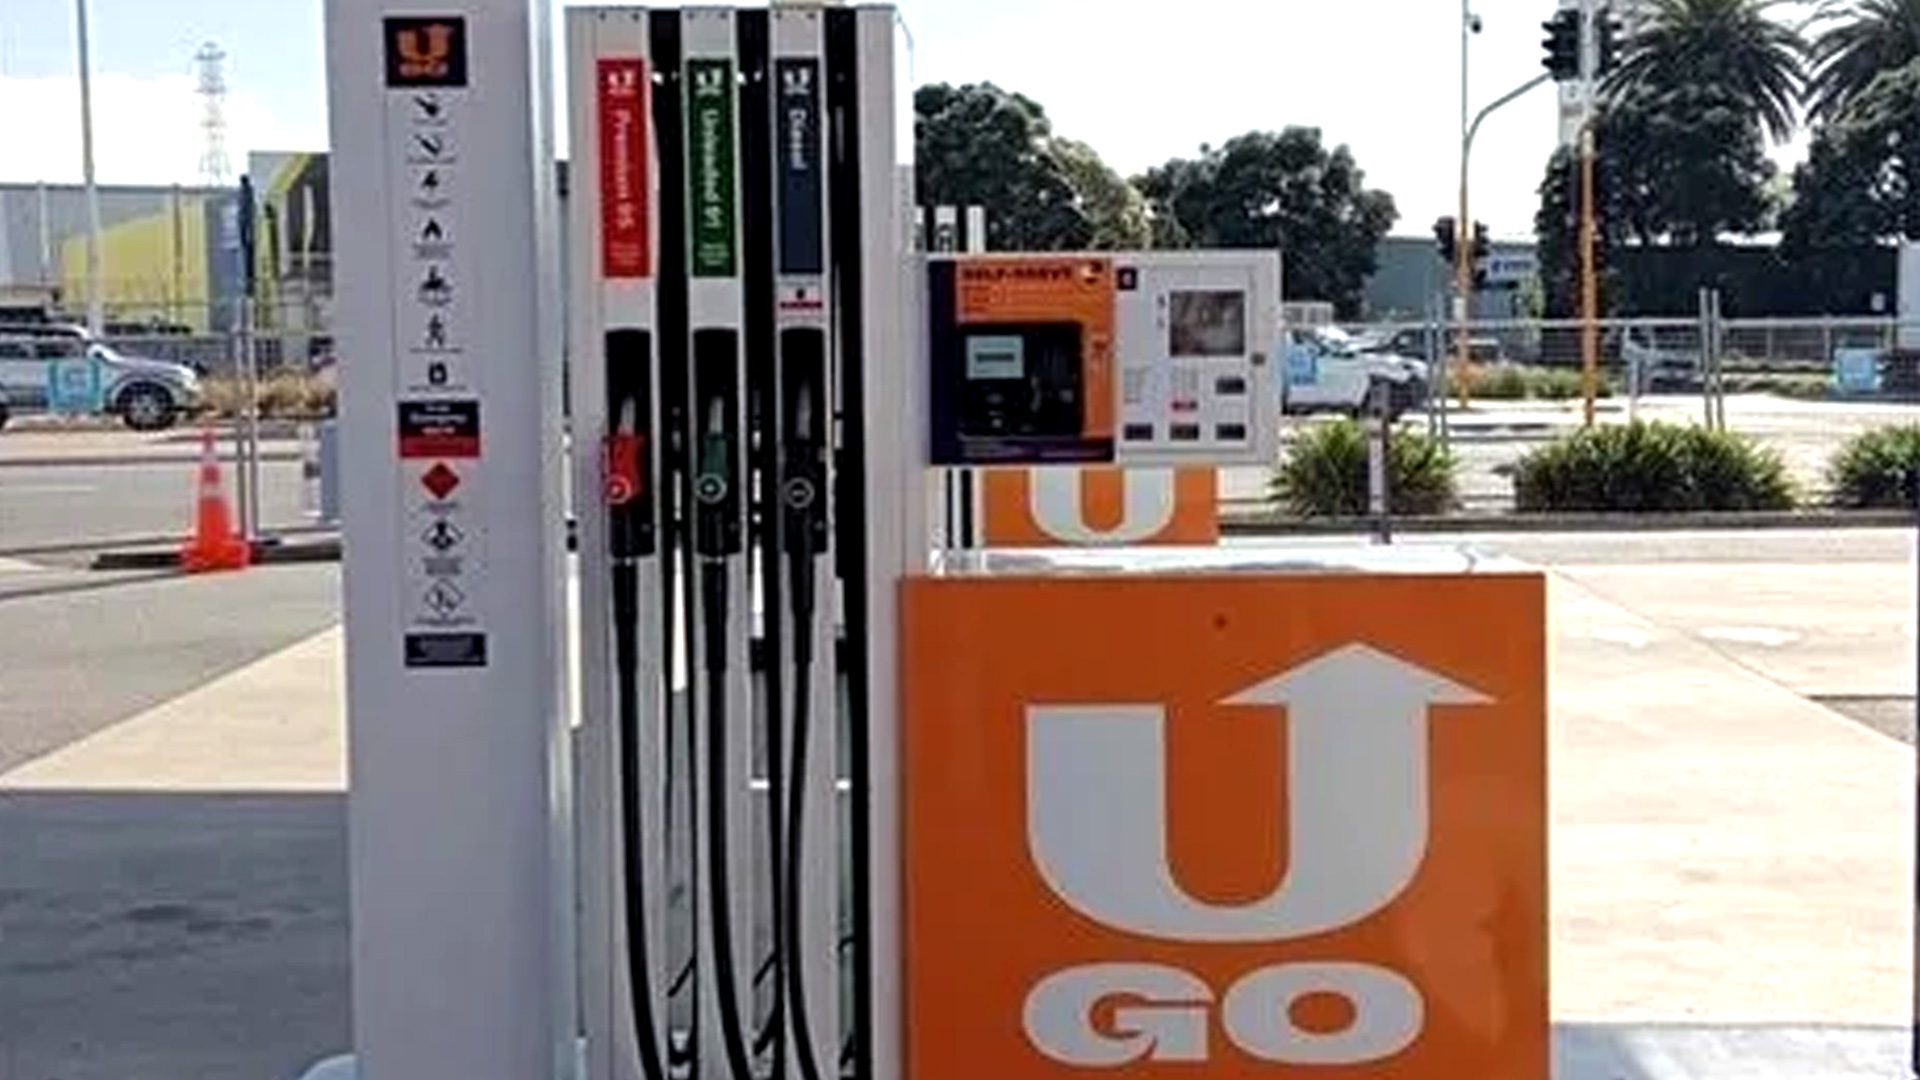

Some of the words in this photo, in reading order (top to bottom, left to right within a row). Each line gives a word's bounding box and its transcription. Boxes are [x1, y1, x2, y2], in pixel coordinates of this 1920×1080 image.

[613, 109, 632, 199] Premium
[702, 109, 721, 202] Unleaded
[788, 108, 808, 170] Diesel
[704, 205, 722, 229] 91
[1025, 642, 1496, 942] U
[1022, 962, 1426, 1068] GO
